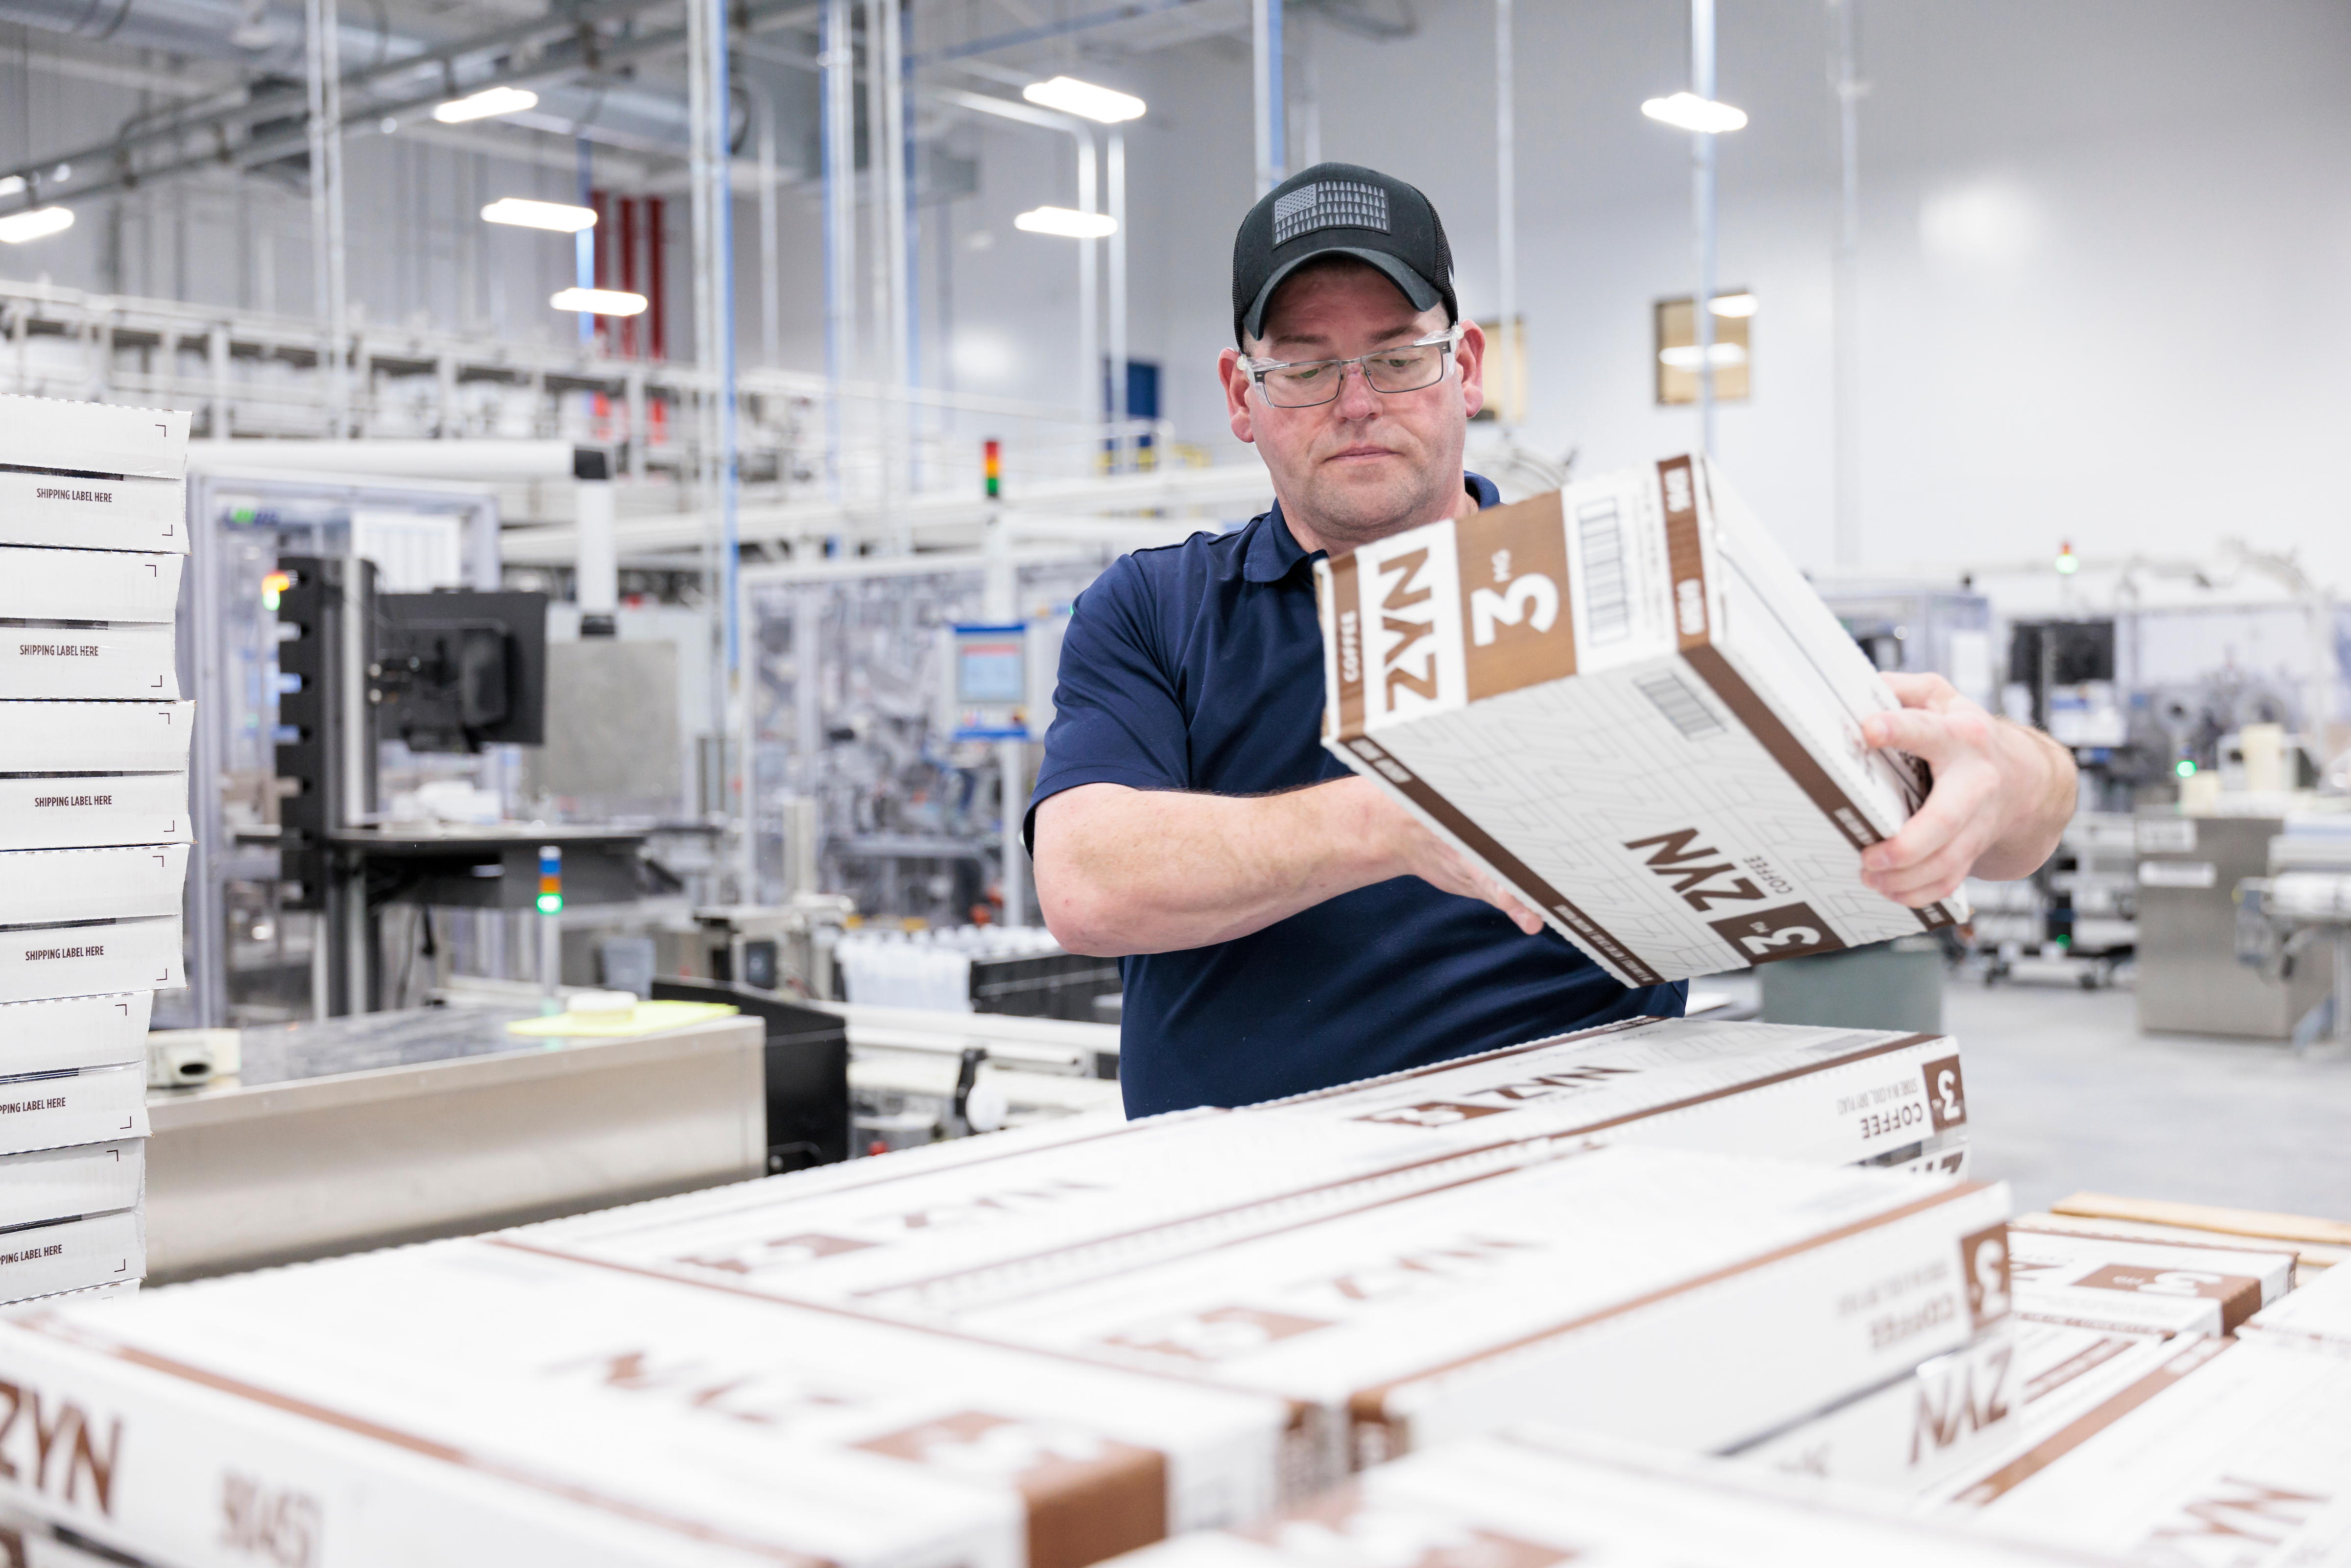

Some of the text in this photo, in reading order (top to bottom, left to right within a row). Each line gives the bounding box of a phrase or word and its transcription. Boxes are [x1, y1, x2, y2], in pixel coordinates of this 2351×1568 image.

[37, 488, 112, 503] SHIPPING LABEL HERE
[1471, 572, 1559, 646] 3
[1378, 546, 1438, 713] ZYN
[20, 644, 98, 656] SHIPPING LABEL HERE
[35, 795, 112, 807] SHIPPING LABEL HERE
[1623, 828, 1767, 912] ZYN
[1743, 855, 1793, 894] COFFEE
[26, 945, 104, 961] SHIPPING LABEL HERE
[1739, 926, 1821, 955] 3
[1900, 1078, 1918, 1096] STORE
[1937, 1069, 1960, 1120] 3
[23, 1099, 45, 1112] LABEL
[47, 1097, 66, 1109] HERE
[1860, 1102, 1923, 1139] COFFEE
[0, 1244, 62, 1265] PING LABEL HERE
